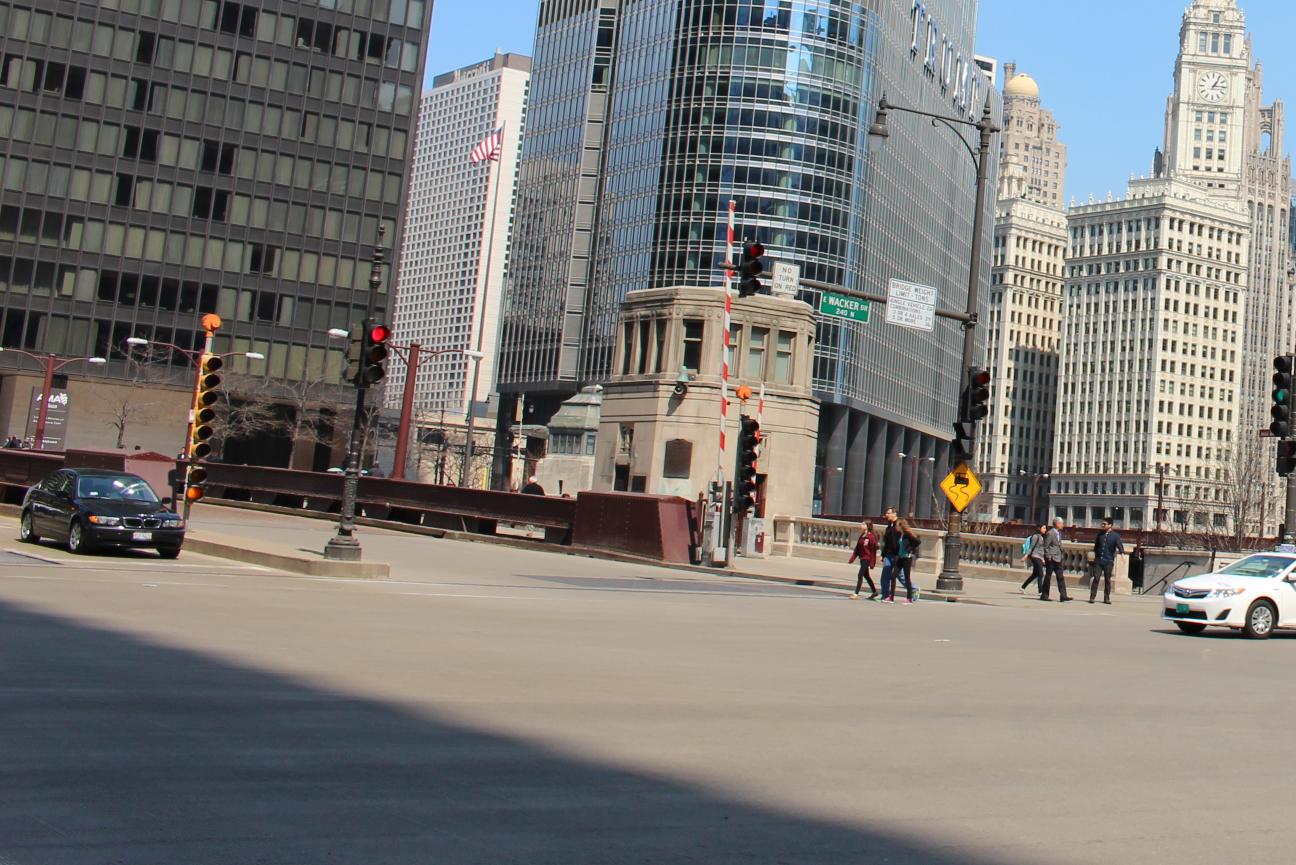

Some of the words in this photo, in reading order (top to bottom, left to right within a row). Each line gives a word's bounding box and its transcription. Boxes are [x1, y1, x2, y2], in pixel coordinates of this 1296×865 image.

[911, 0, 983, 119] TRUMP
[782, 266, 793, 274] NO
[778, 274, 794, 282] TURN
[891, 281, 912, 292] BRIDGE
[915, 287, 934, 297] WEIGHT
[828, 296, 859, 311] WACKER
[835, 308, 848, 316] 240
